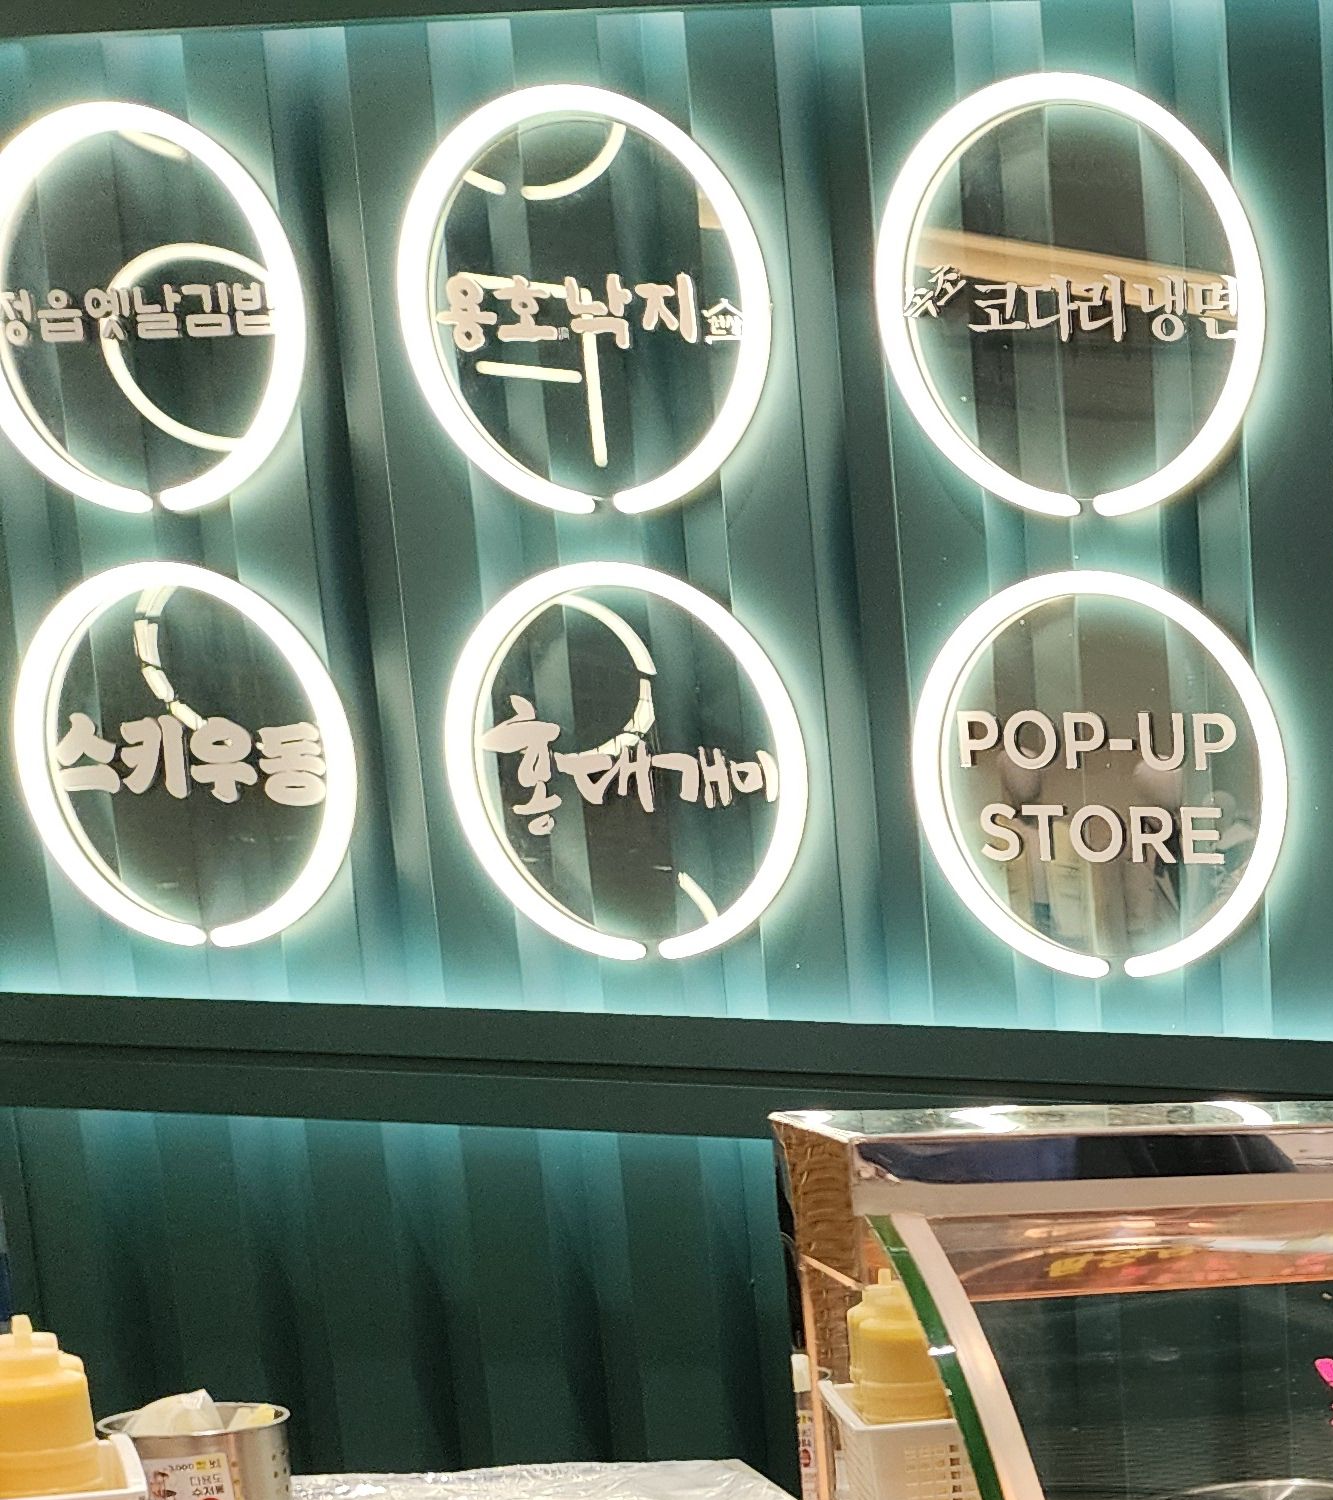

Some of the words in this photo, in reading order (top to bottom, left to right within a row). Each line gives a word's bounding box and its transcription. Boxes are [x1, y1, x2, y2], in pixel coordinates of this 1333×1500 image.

[436, 271, 698, 352] 용호낙지
[56, 712, 328, 807] 스키우동
[482, 695, 780, 836] 홍대개미
[955, 710, 1238, 772] POP-UP
[979, 802, 1228, 867] STORE
